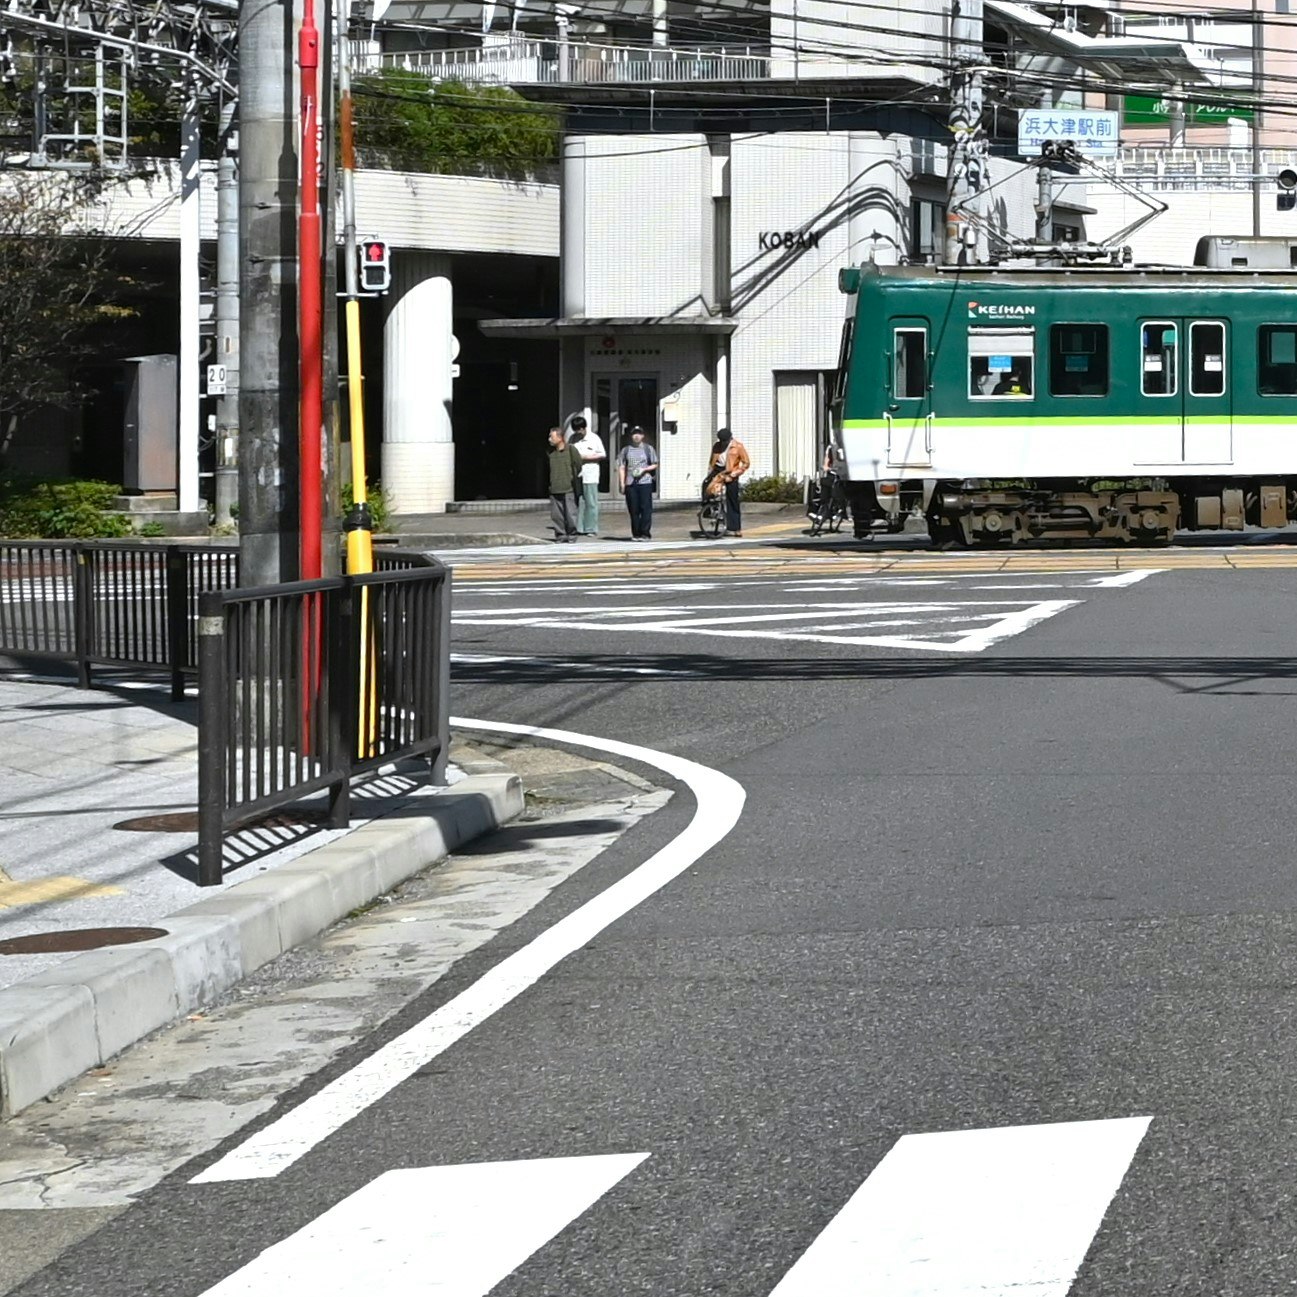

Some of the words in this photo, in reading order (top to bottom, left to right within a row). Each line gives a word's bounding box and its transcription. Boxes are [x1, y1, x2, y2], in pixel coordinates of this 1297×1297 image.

[1025, 117, 1112, 136] 浜大津駅前
[758, 231, 819, 250] KOBAN
[978, 305, 1035, 314] KEIHAN
